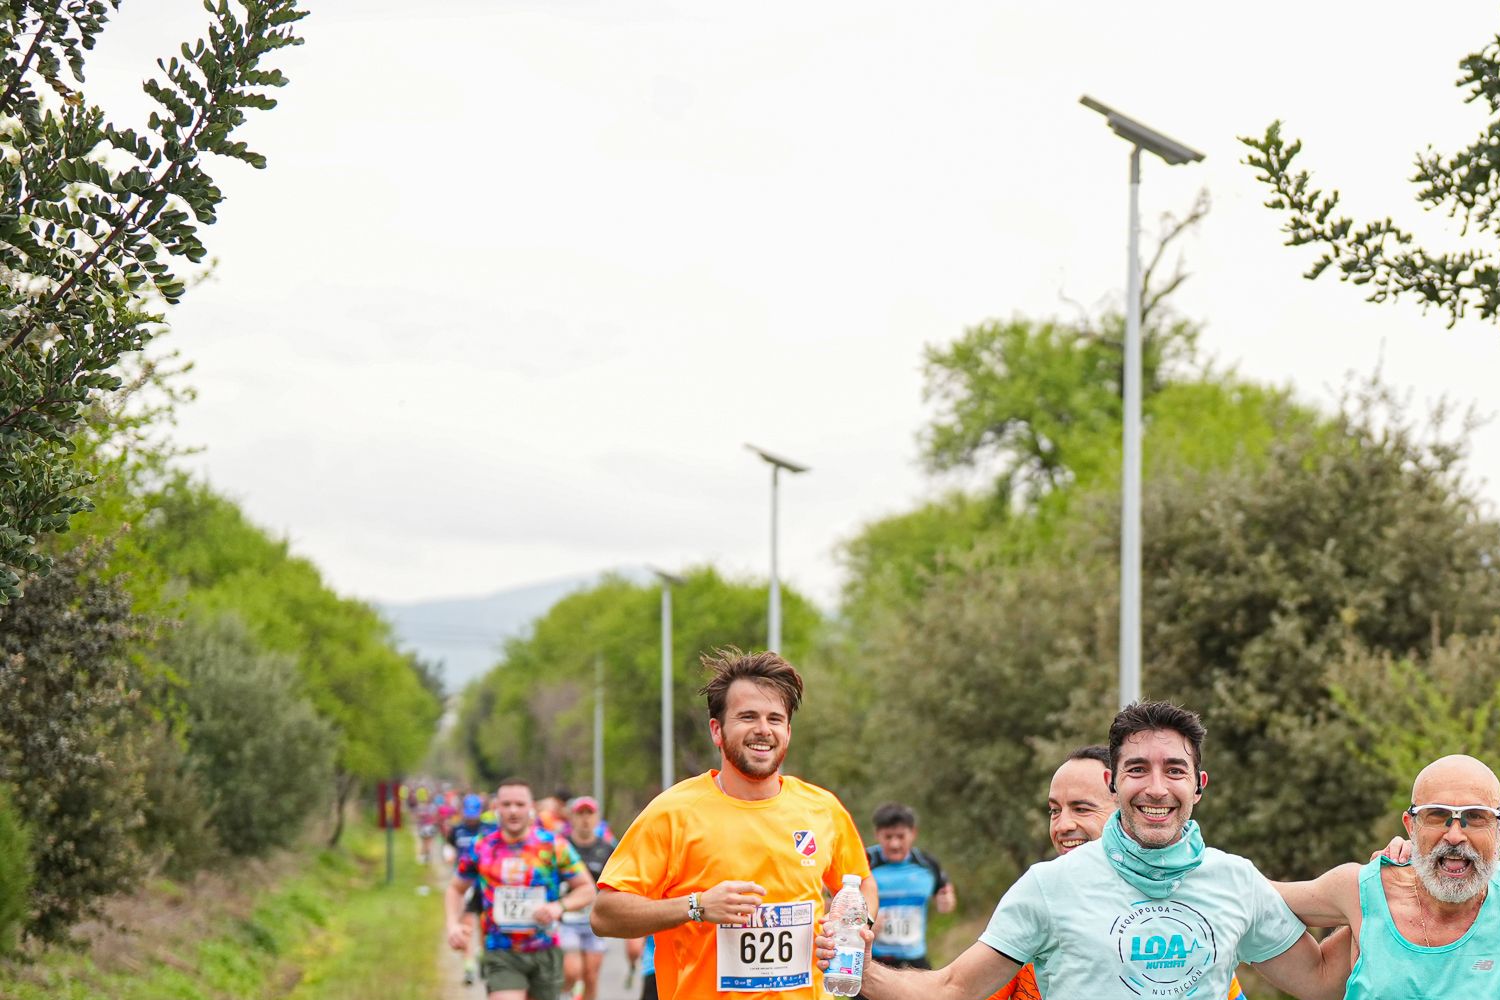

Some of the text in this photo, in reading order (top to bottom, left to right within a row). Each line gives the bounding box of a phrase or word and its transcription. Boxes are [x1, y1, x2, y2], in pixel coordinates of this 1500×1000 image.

[740, 930, 793, 964] 626
[1131, 935, 1187, 961] LOA
[1146, 960, 1186, 970] NUTRIFIT
